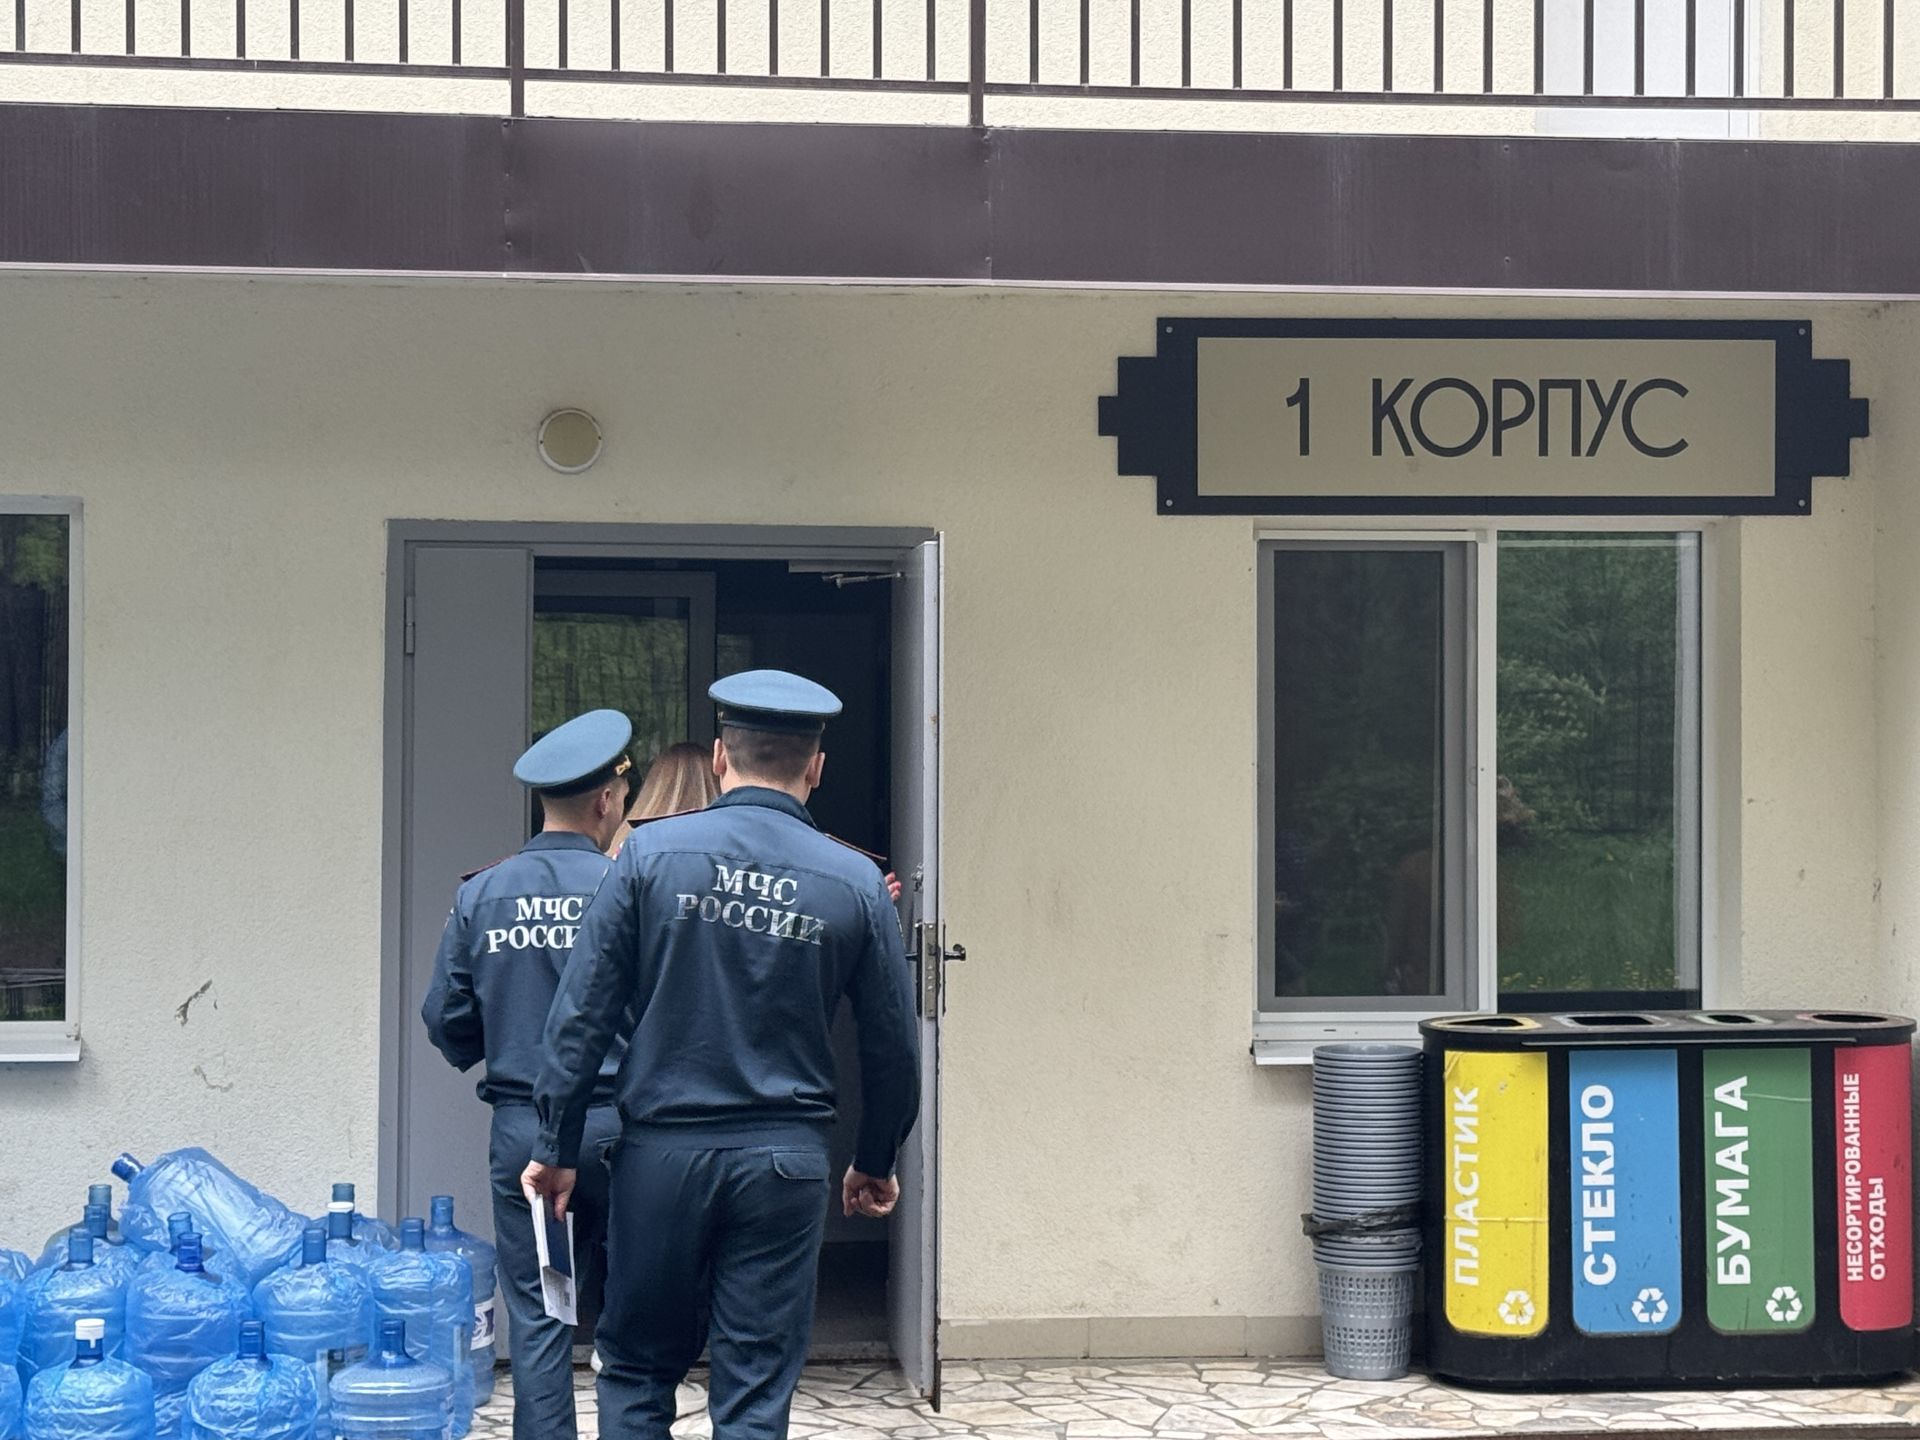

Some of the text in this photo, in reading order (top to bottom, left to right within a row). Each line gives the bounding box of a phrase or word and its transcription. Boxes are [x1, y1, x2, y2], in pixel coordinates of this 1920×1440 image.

[1286, 378, 1689, 458] 1 КОРПУС
[515, 897, 583, 921] МЧС
[672, 894, 829, 946] РОССИИ
[711, 864, 798, 906] МЧС
[486, 925, 581, 953] РОССИ
[1454, 1086, 1479, 1286] ПЛАСТИК
[1580, 1085, 1617, 1286] СТЕКЛО
[1714, 1075, 1751, 1285] БУМАГА
[1842, 1073, 1864, 1282] НЕСОРТИРОВАННЫЕ
[1868, 1177, 1886, 1281] ОТХОДЫ
